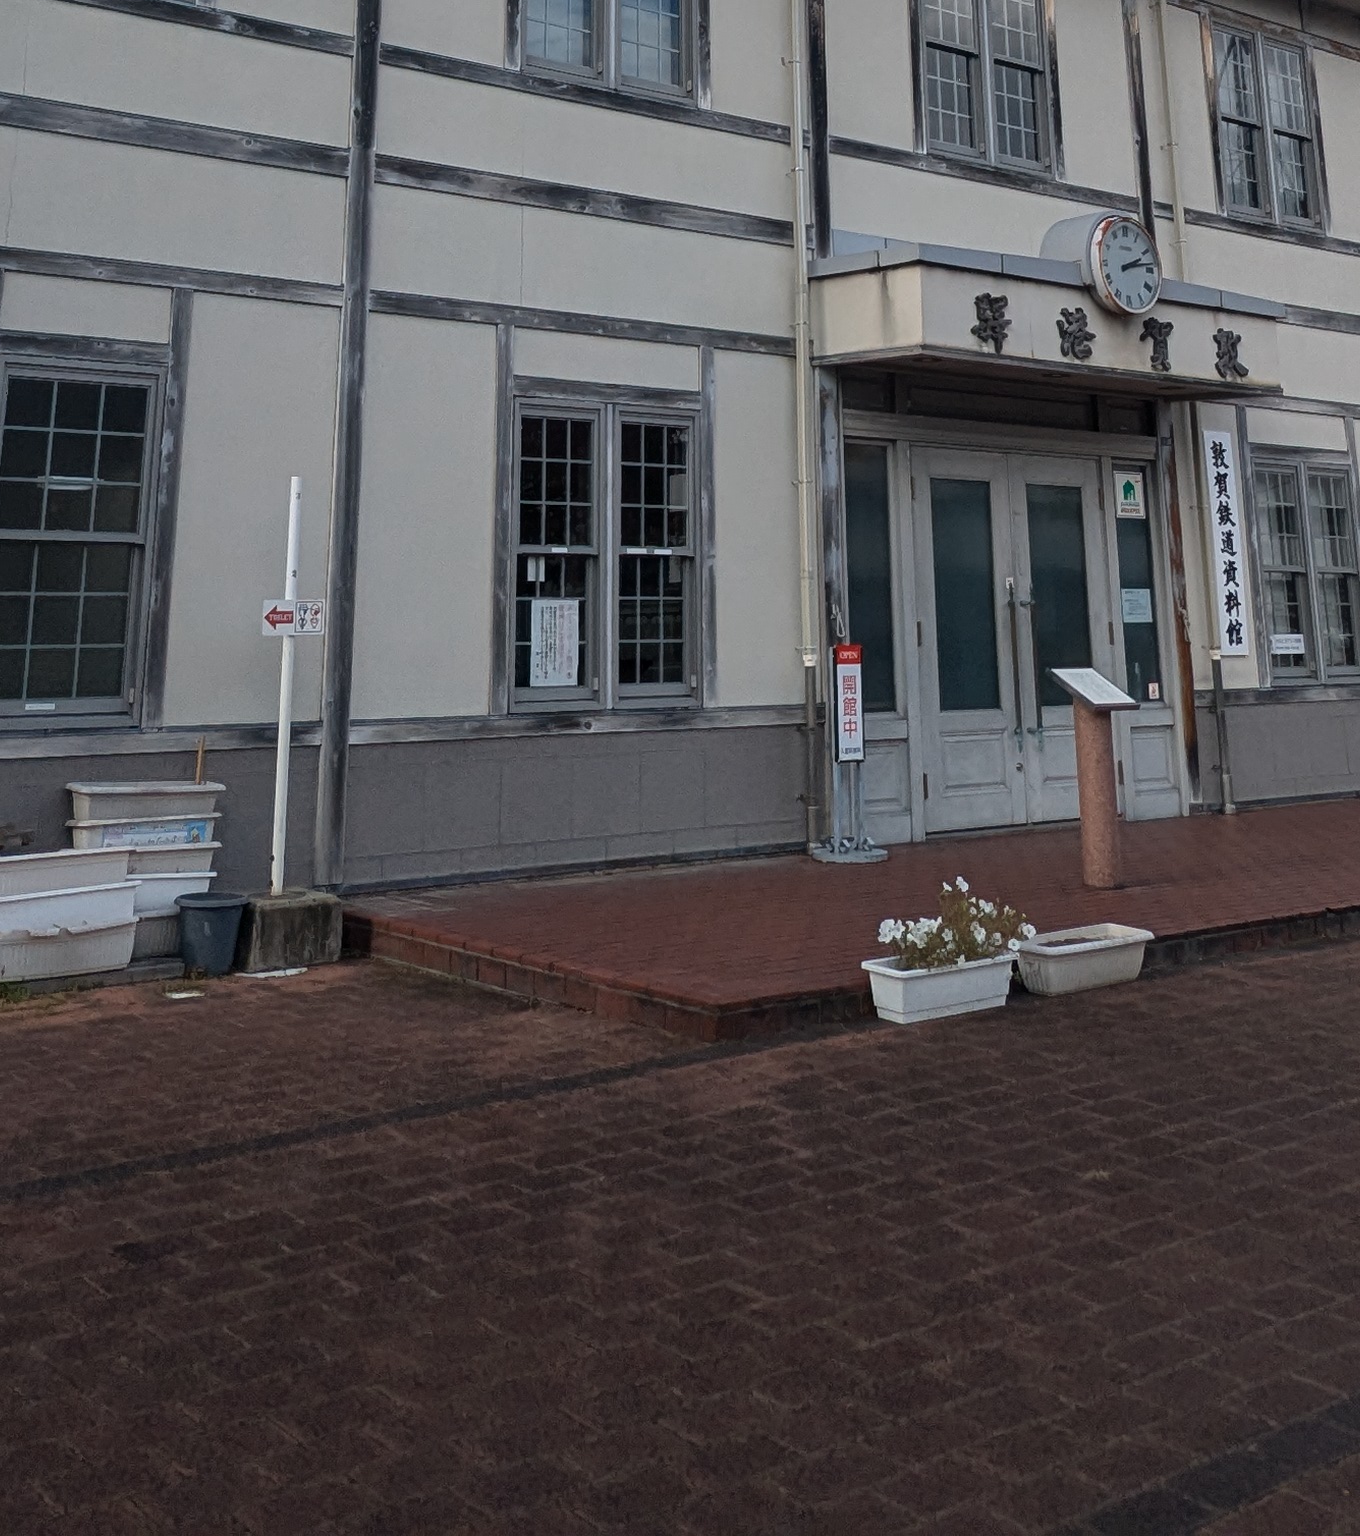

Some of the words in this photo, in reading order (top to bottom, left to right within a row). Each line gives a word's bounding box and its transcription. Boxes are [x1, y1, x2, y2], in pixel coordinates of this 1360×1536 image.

[1210, 440, 1243, 647] 敦賀鉄道資料館
[268, 613, 293, 622] TOILET
[839, 650, 859, 660] OPEN
[842, 674, 858, 739] 開館中
